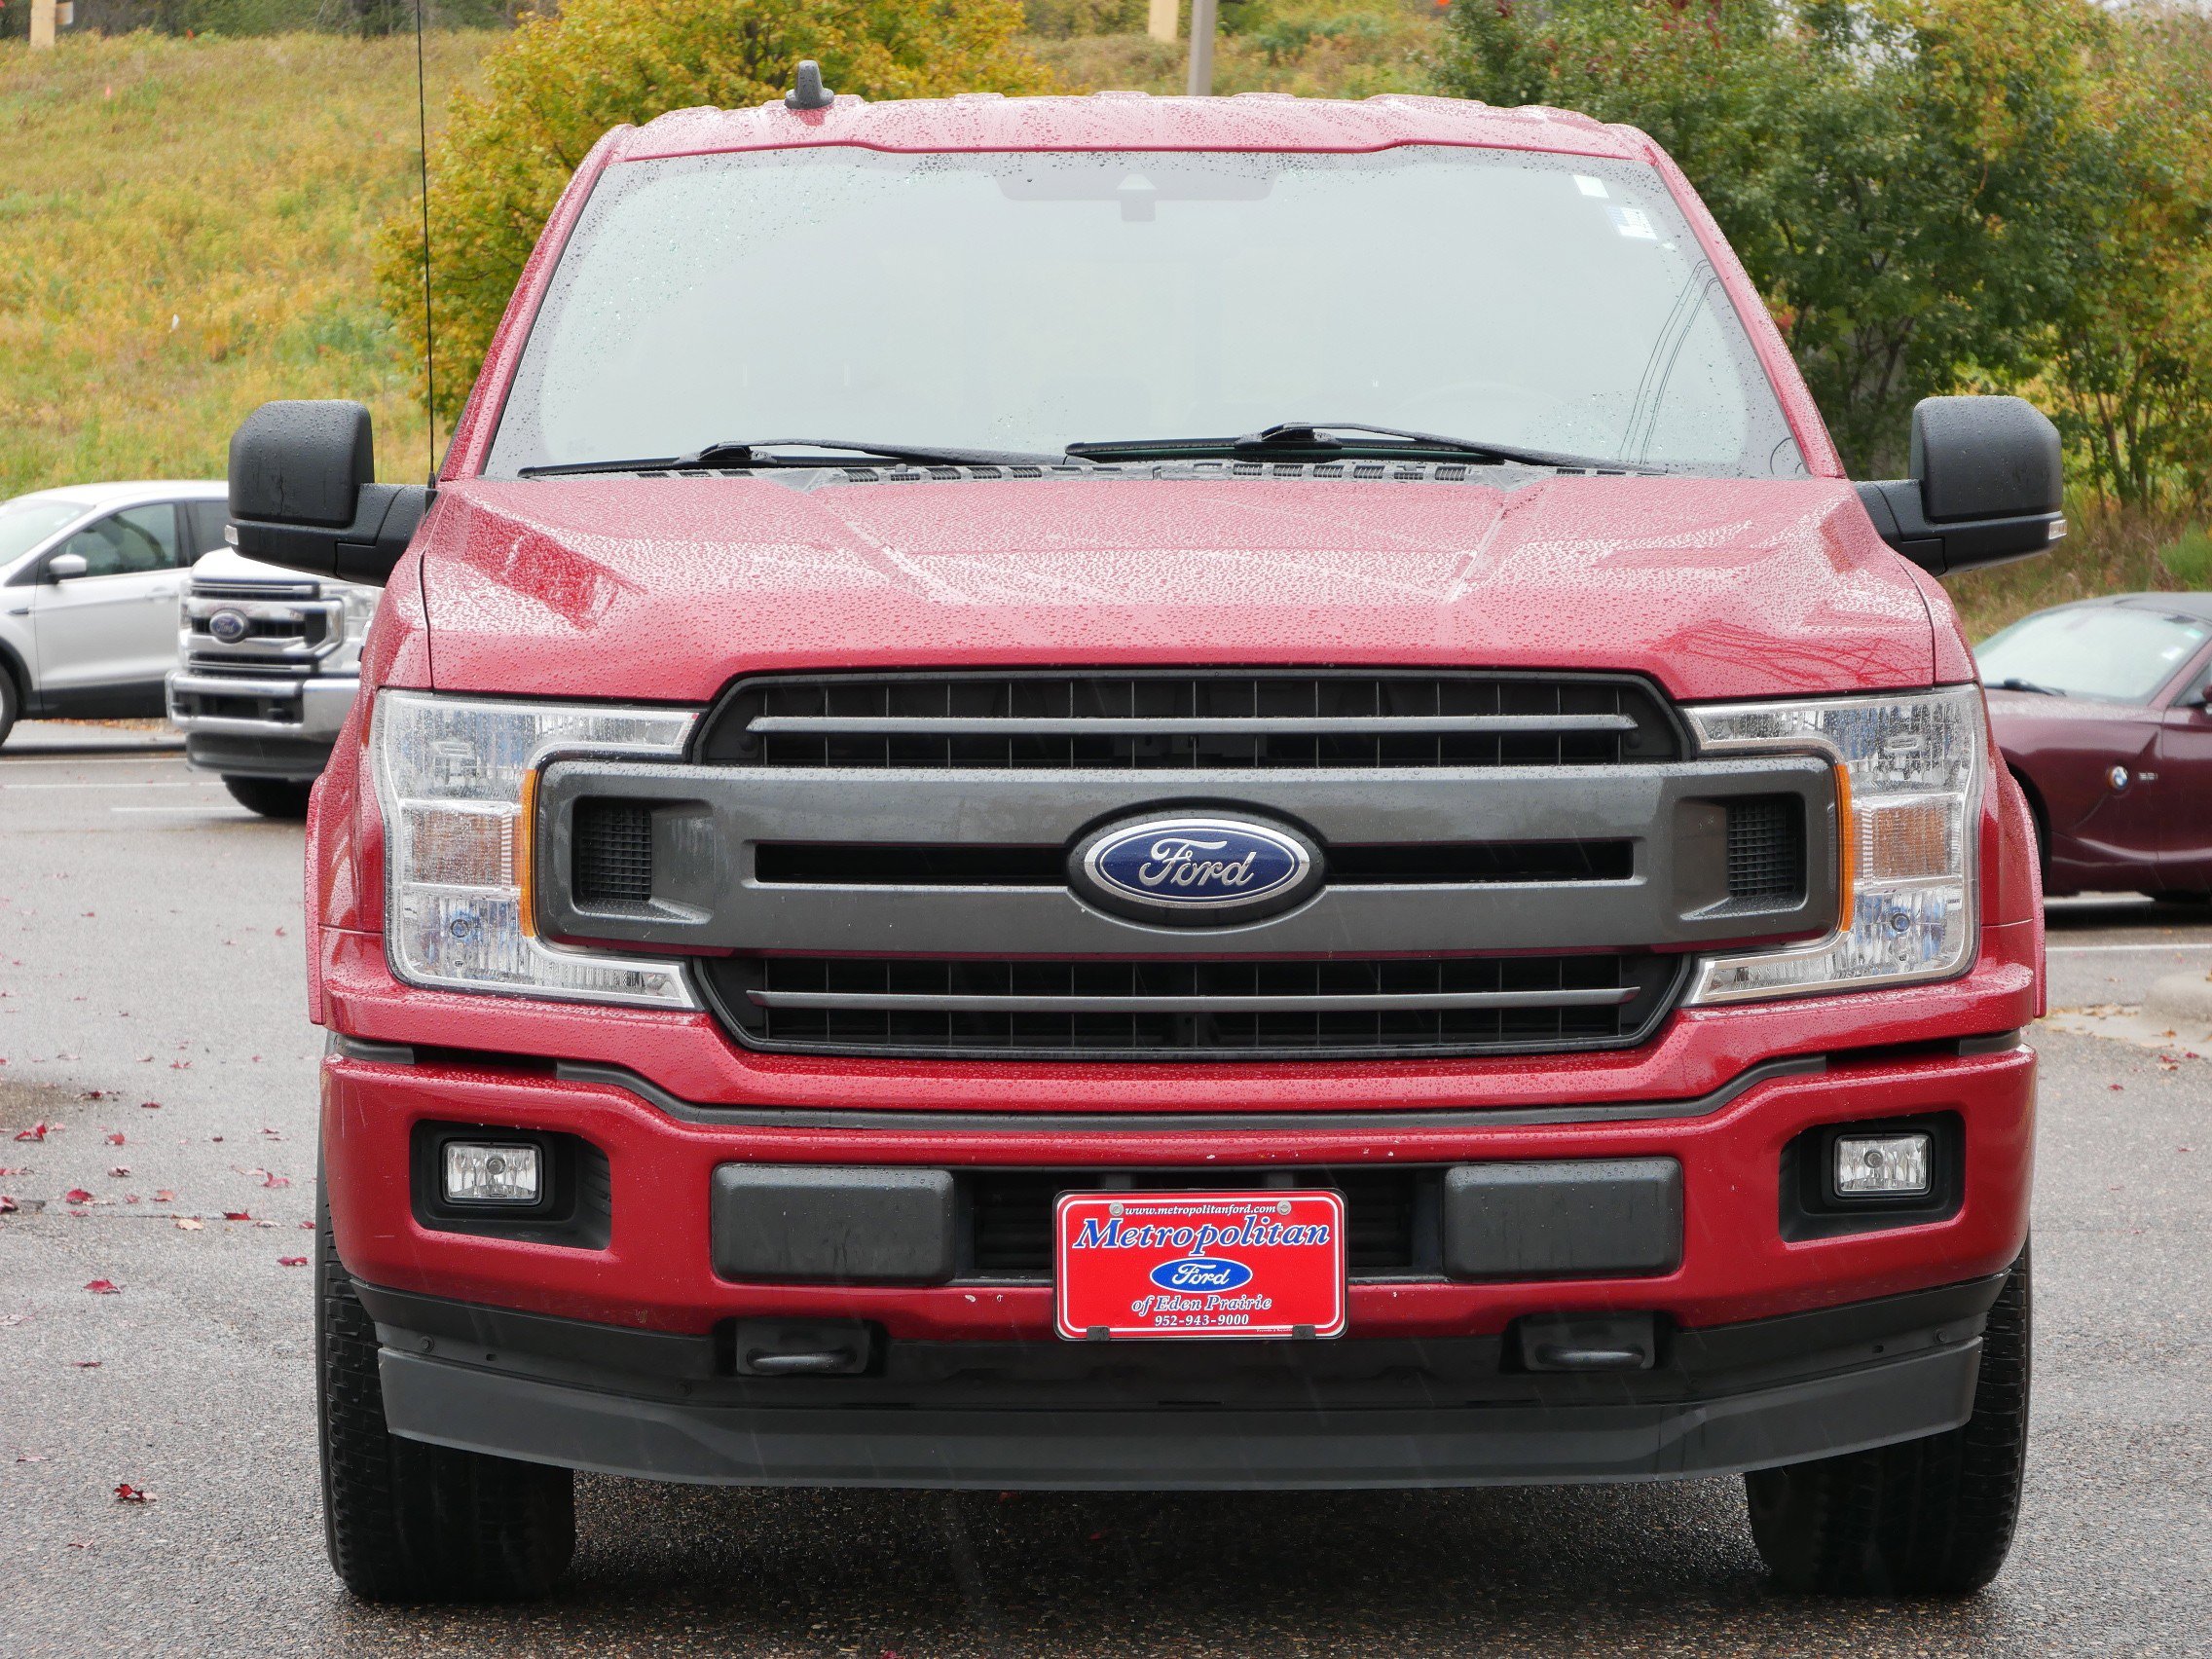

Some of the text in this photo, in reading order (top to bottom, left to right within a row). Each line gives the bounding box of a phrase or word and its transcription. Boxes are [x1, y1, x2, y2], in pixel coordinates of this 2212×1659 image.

[1138, 837, 1257, 886] Ford
[1124, 1204, 1275, 1216] www.metropolitanford.com
[1073, 1215, 1330, 1256] Metropolitan
[1171, 1263, 1231, 1285] Ford
[1131, 1294, 1272, 1316] of Eden Prairie
[1155, 1314, 1249, 1326] 952-943-9000
